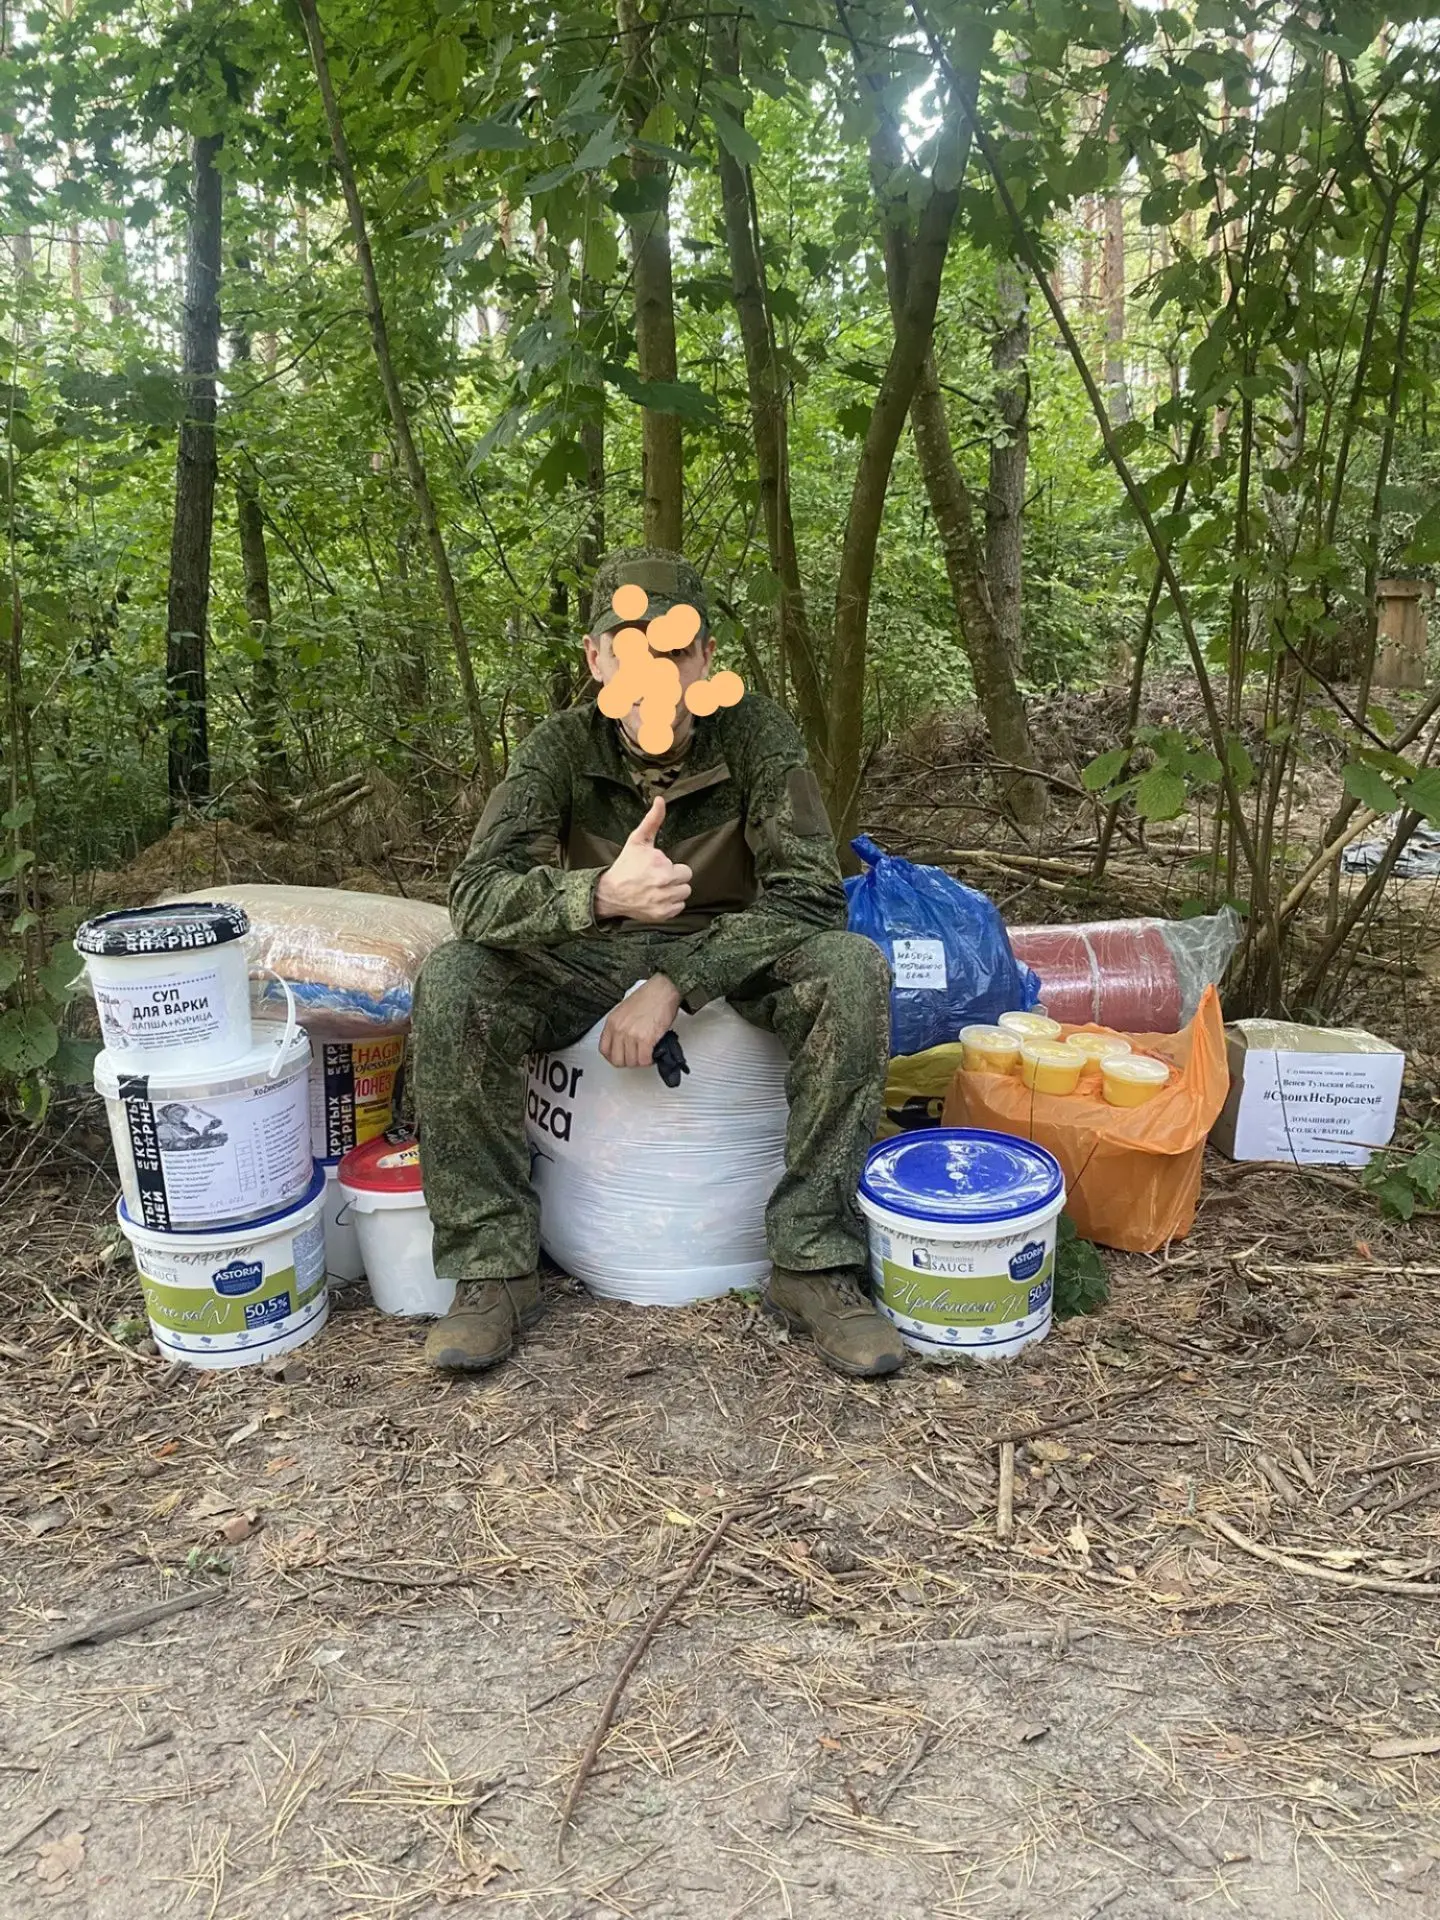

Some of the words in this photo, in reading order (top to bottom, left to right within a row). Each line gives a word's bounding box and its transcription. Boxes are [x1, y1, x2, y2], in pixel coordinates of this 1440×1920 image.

[152, 988, 180, 1003] СУП
[132, 1006, 160, 1021] ДЛЯ
[164, 997, 209, 1016] ВАРКИ
[1308, 1080, 1344, 1089] Тульская
[1345, 1081, 1375, 1089] область
[1263, 1090, 1382, 1106] #СвоихНеБросаем#
[328, 1096, 342, 1157] КРУТЫХ
[215, 1266, 262, 1282] ASTORIA
[931, 1262, 975, 1273] SAUCE
[245, 1297, 289, 1319] 50,5%
